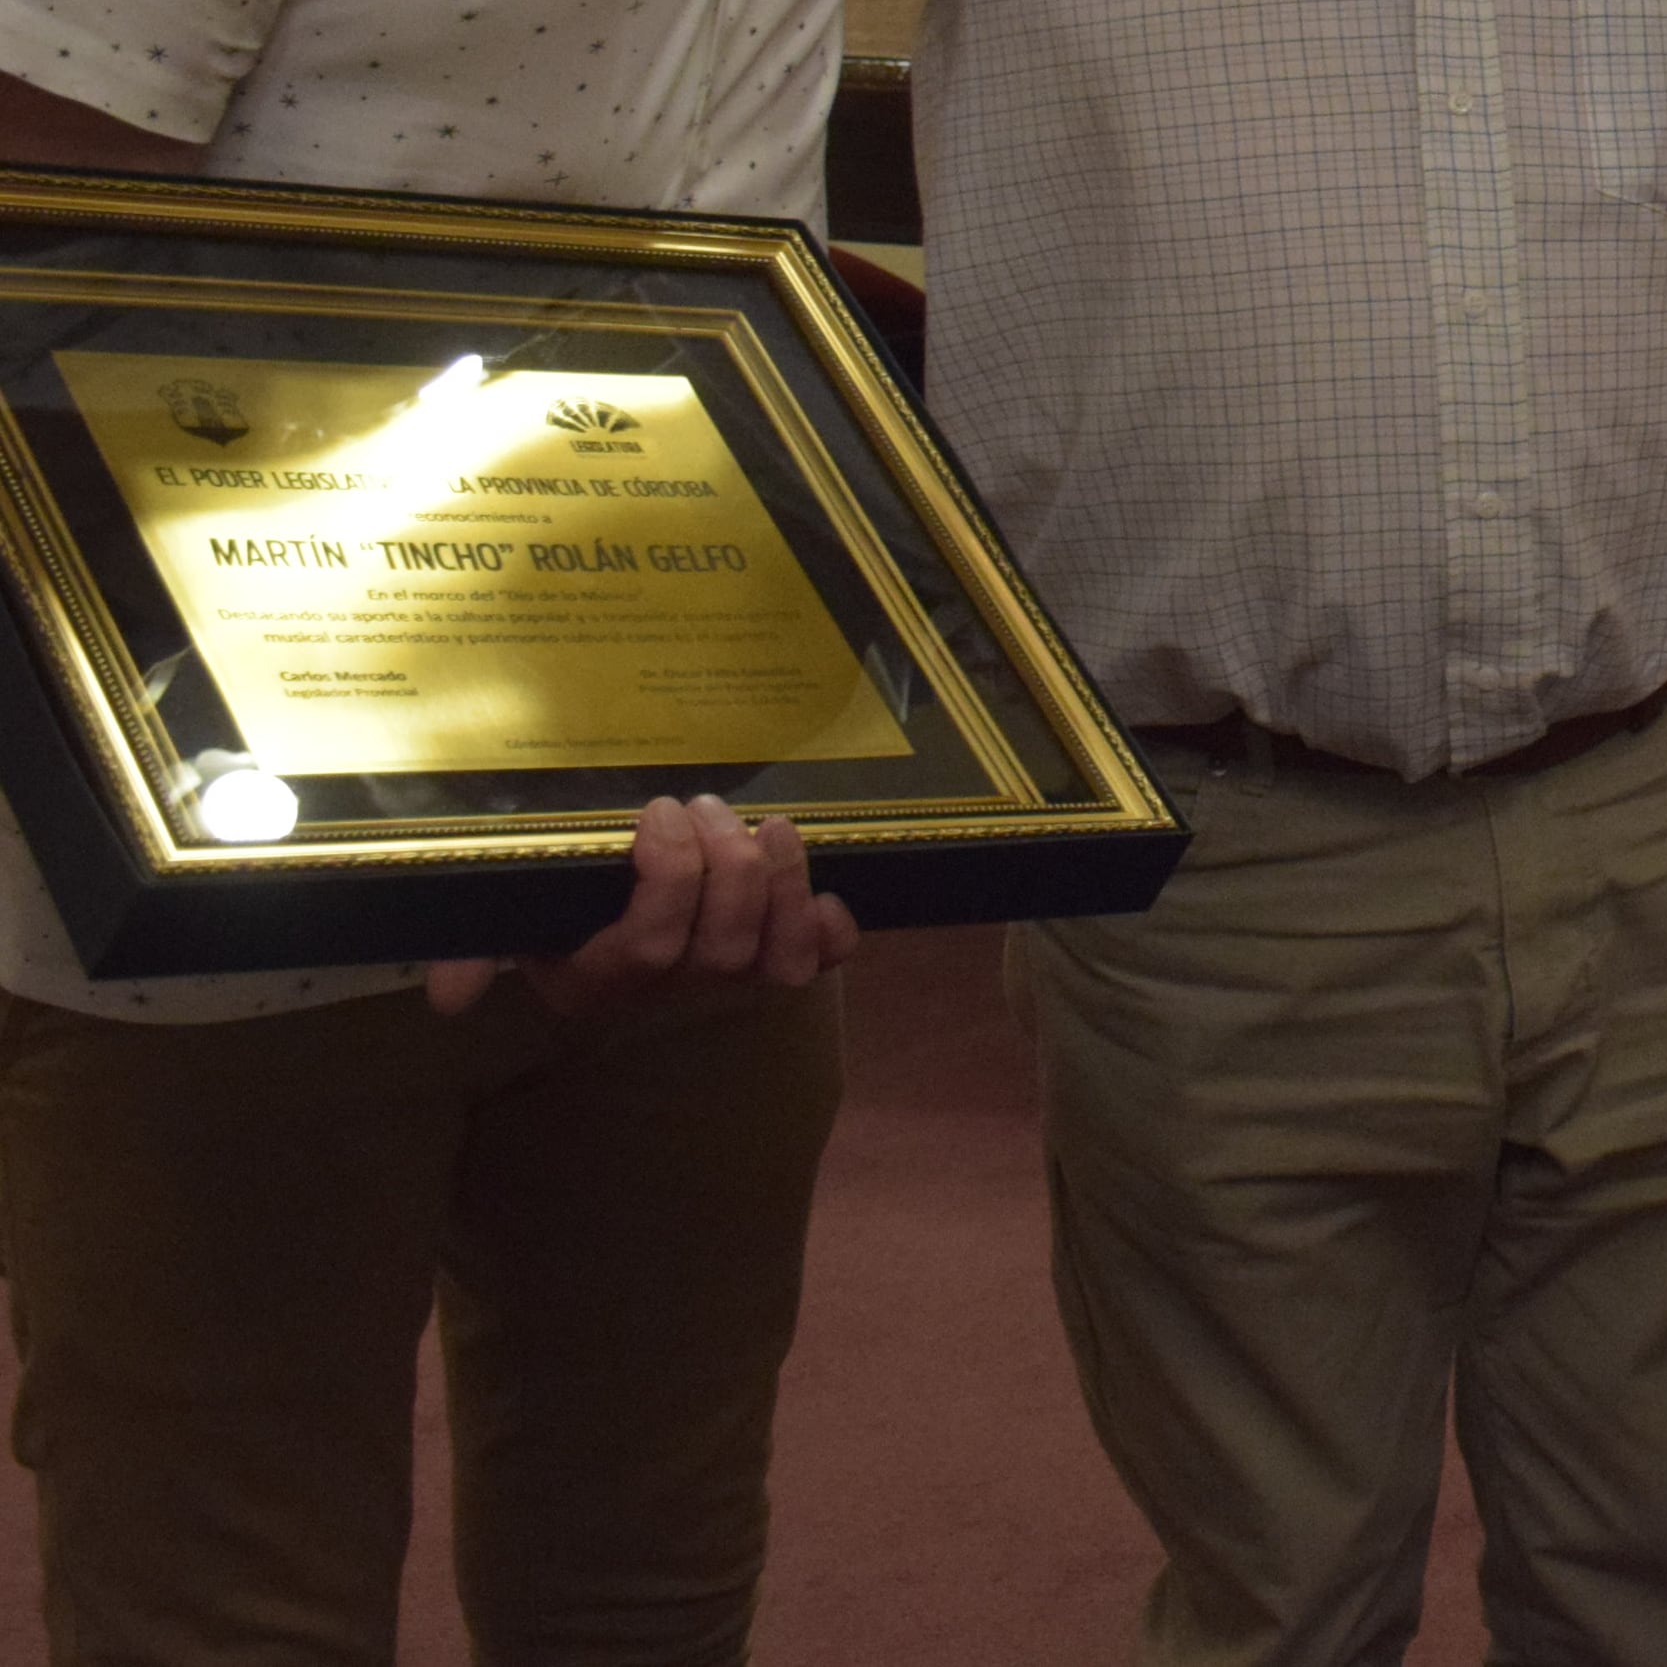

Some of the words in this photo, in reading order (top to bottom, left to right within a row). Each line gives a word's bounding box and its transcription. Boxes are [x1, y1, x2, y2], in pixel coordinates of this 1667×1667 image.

[155, 467, 186, 485] EL
[190, 468, 265, 487] PODER
[477, 477, 587, 497] PROVINCIA
[589, 478, 621, 497] DE
[623, 477, 719, 498] CÓRDOBA
[412, 512, 537, 524] econocimiento
[209, 534, 349, 569] MARTÍN
[526, 537, 641, 573] ROLÁN
[648, 543, 748, 573] GELFO
[368, 589, 388, 601] En
[394, 589, 408, 601] el
[413, 591, 465, 602] marco
[470, 591, 495, 602] del
[217, 609, 323, 622] Destacando
[352, 612, 409, 625] aporte
[263, 632, 329, 644] musical
[279, 670, 330, 682] Carlos
[334, 670, 407, 682] Mercado
